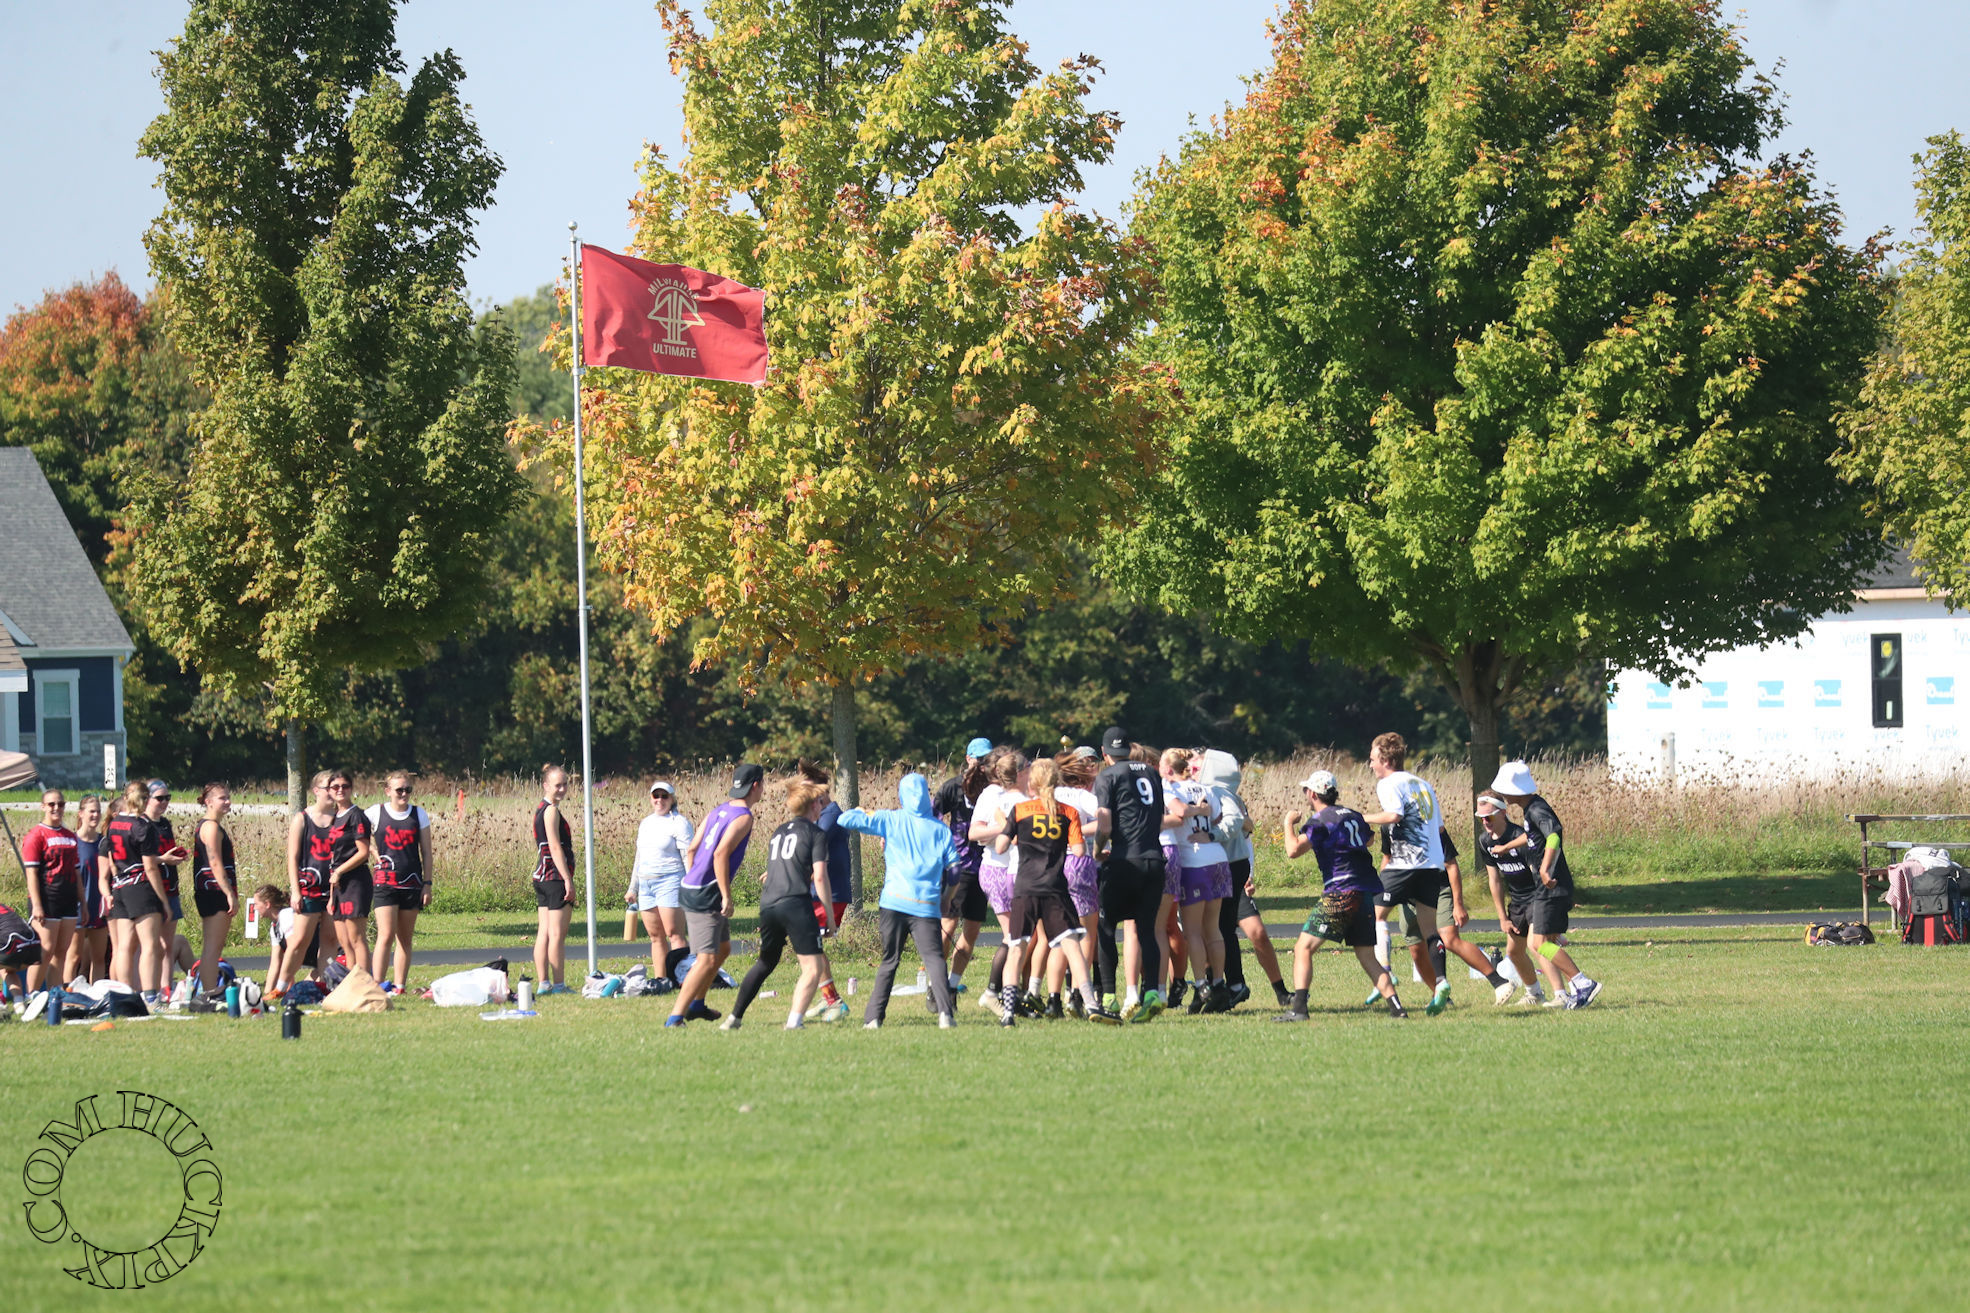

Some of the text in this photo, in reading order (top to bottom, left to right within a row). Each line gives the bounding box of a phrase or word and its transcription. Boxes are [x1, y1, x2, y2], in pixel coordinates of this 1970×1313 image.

[647, 277, 700, 299] MILWAU
[653, 343, 697, 359] ULTIMATE
[1925, 722, 1958, 743] Tyvek
[1136, 777, 1154, 805] 9
[704, 822, 720, 850] 4
[1032, 814, 1062, 840] 55
[1344, 819, 1363, 847] 11
[770, 833, 797, 860] 10
